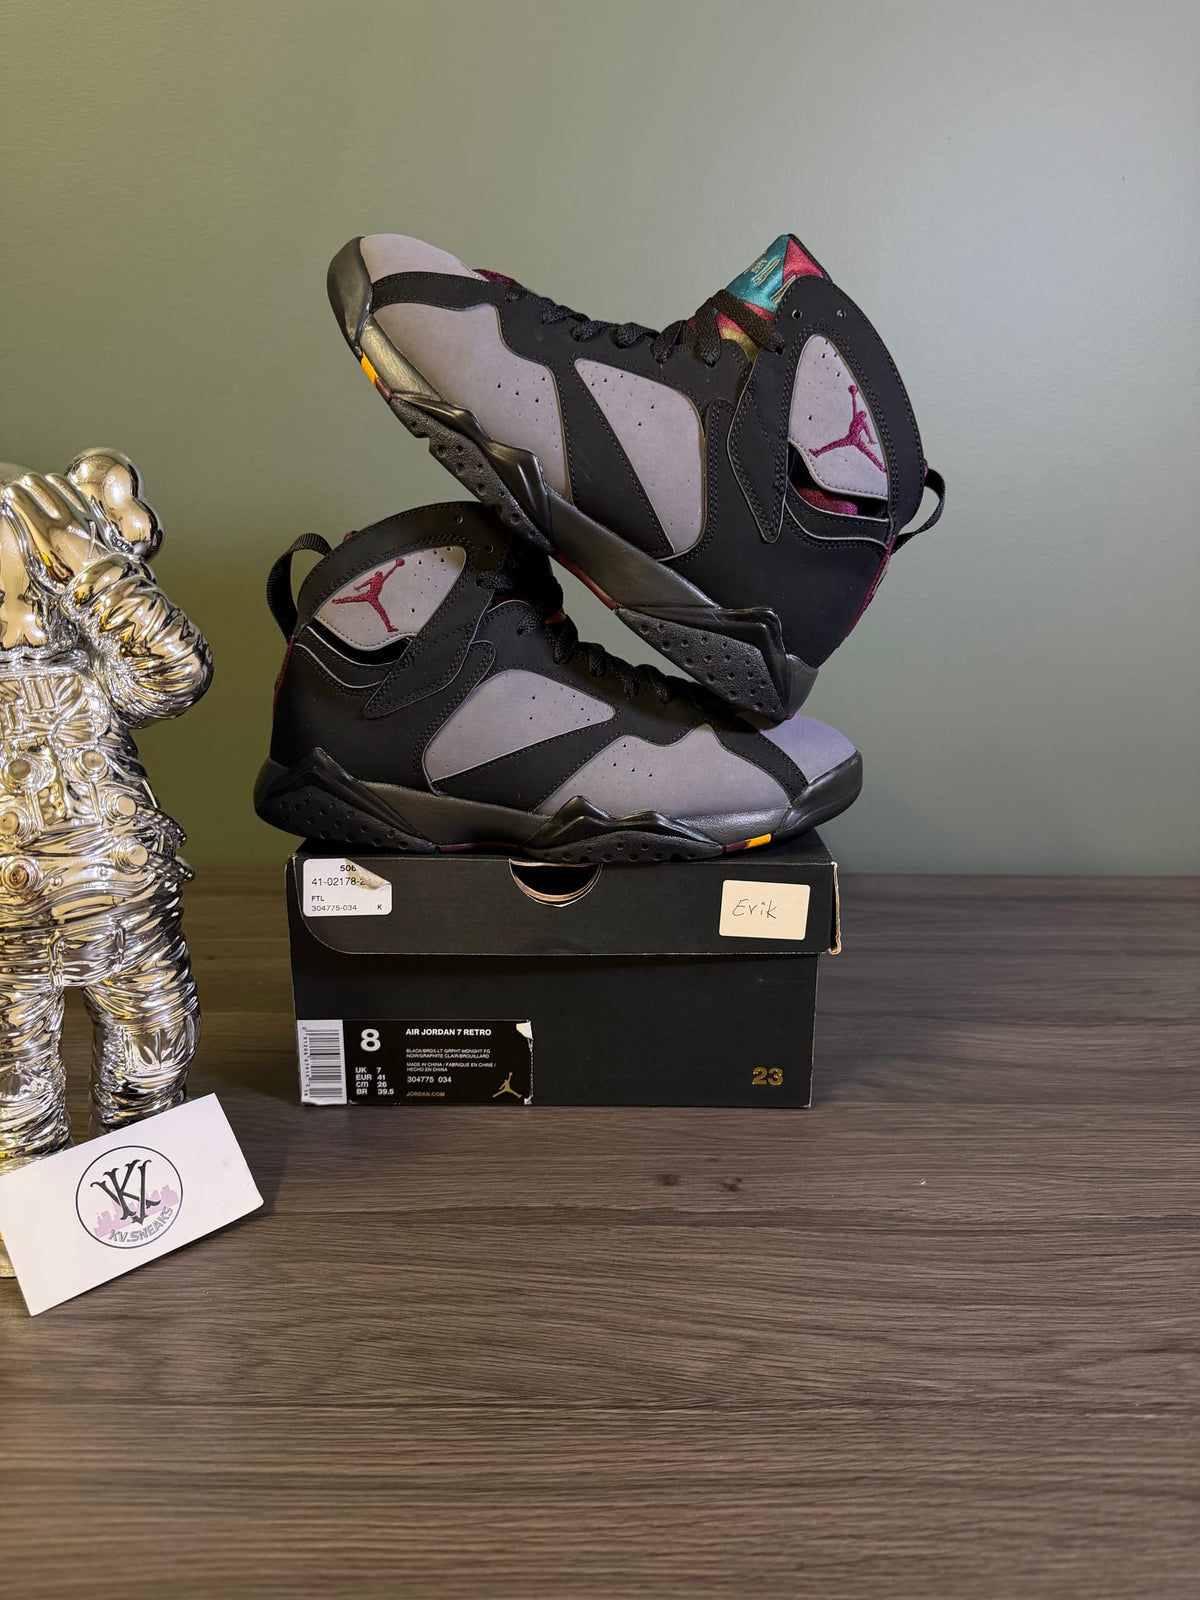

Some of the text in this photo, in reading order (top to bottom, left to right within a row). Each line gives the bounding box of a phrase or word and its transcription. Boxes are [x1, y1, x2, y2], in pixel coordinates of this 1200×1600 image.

[311, 904, 357, 912] 304775-034
[732, 898, 777, 919] Erik
[360, 1028, 381, 1052] 8
[405, 1028, 492, 1036] AIR JORDAN 7 RETRO
[752, 1066, 784, 1086] 23
[108, 1205, 174, 1243] KV.SNEAKS
